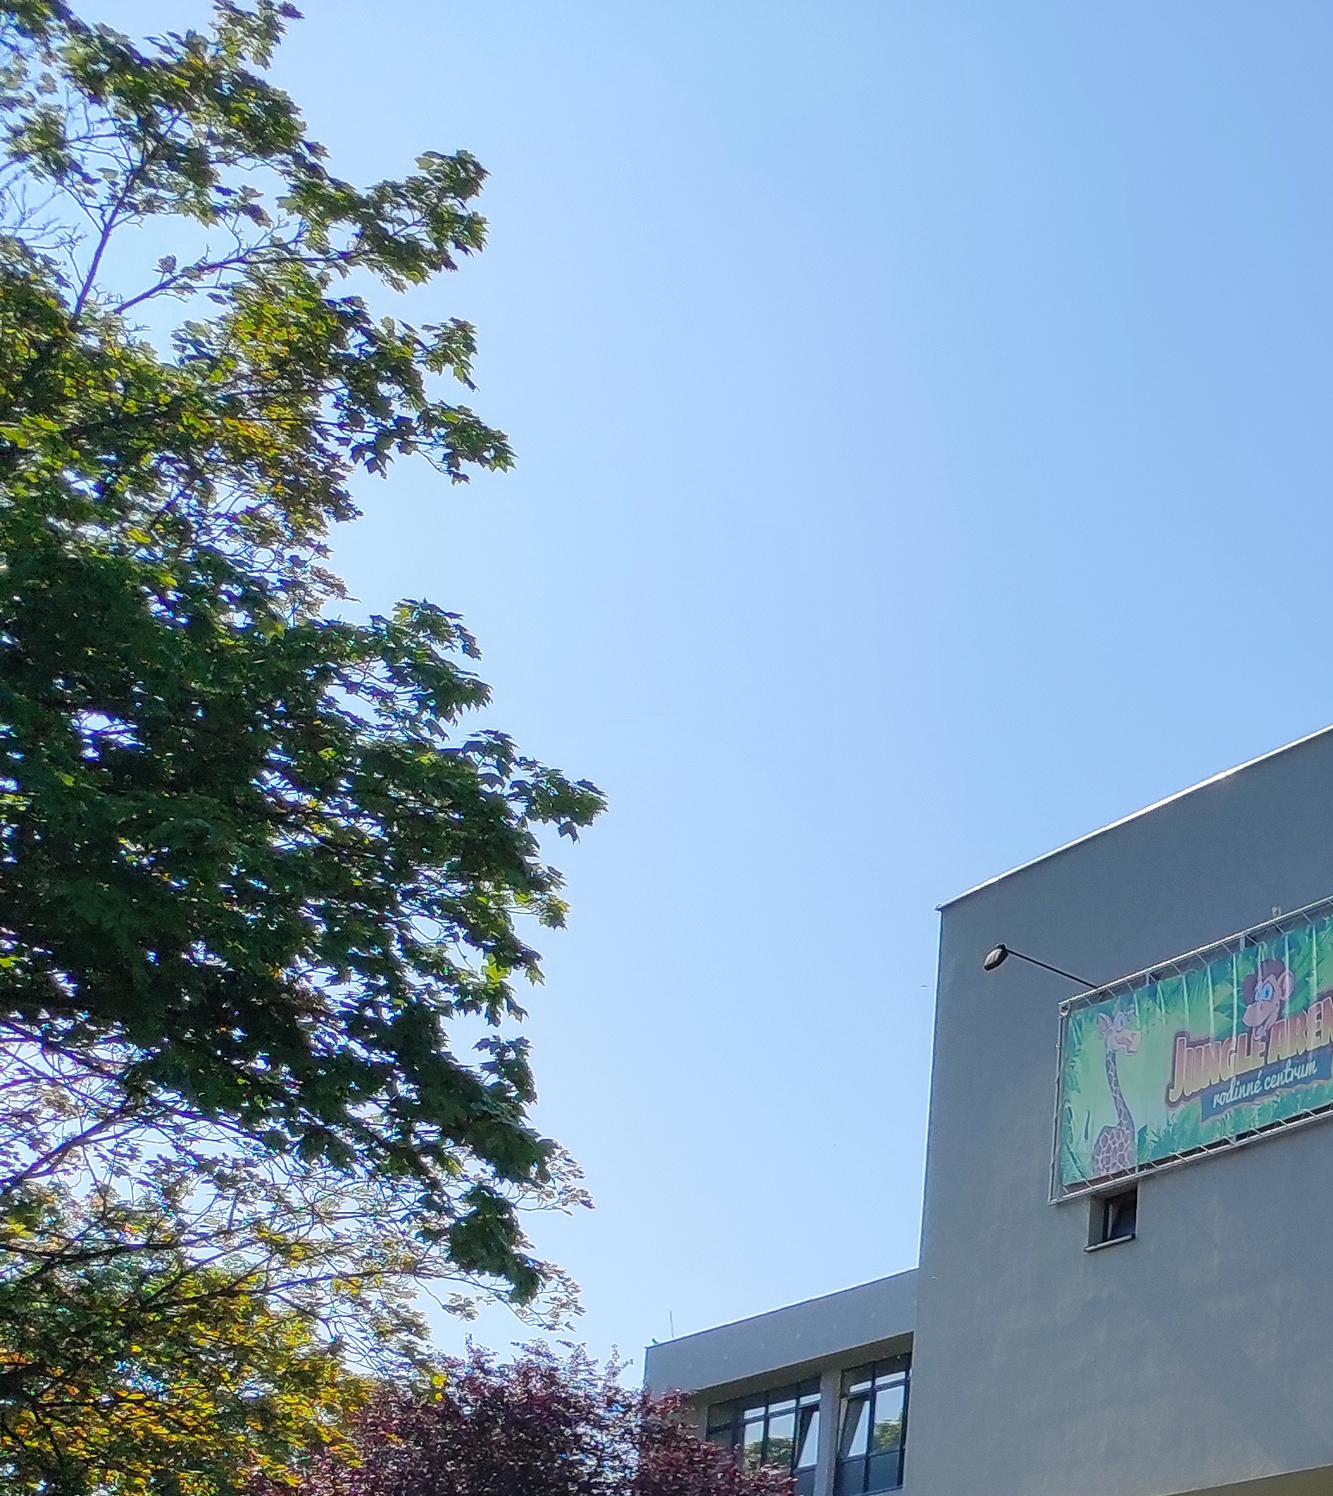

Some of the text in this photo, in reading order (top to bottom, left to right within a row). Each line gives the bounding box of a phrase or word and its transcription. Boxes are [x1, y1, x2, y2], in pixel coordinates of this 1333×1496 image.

[1168, 1033, 1266, 1102] JUNGLE
[1212, 1058, 1318, 1108] rodinné centrum
